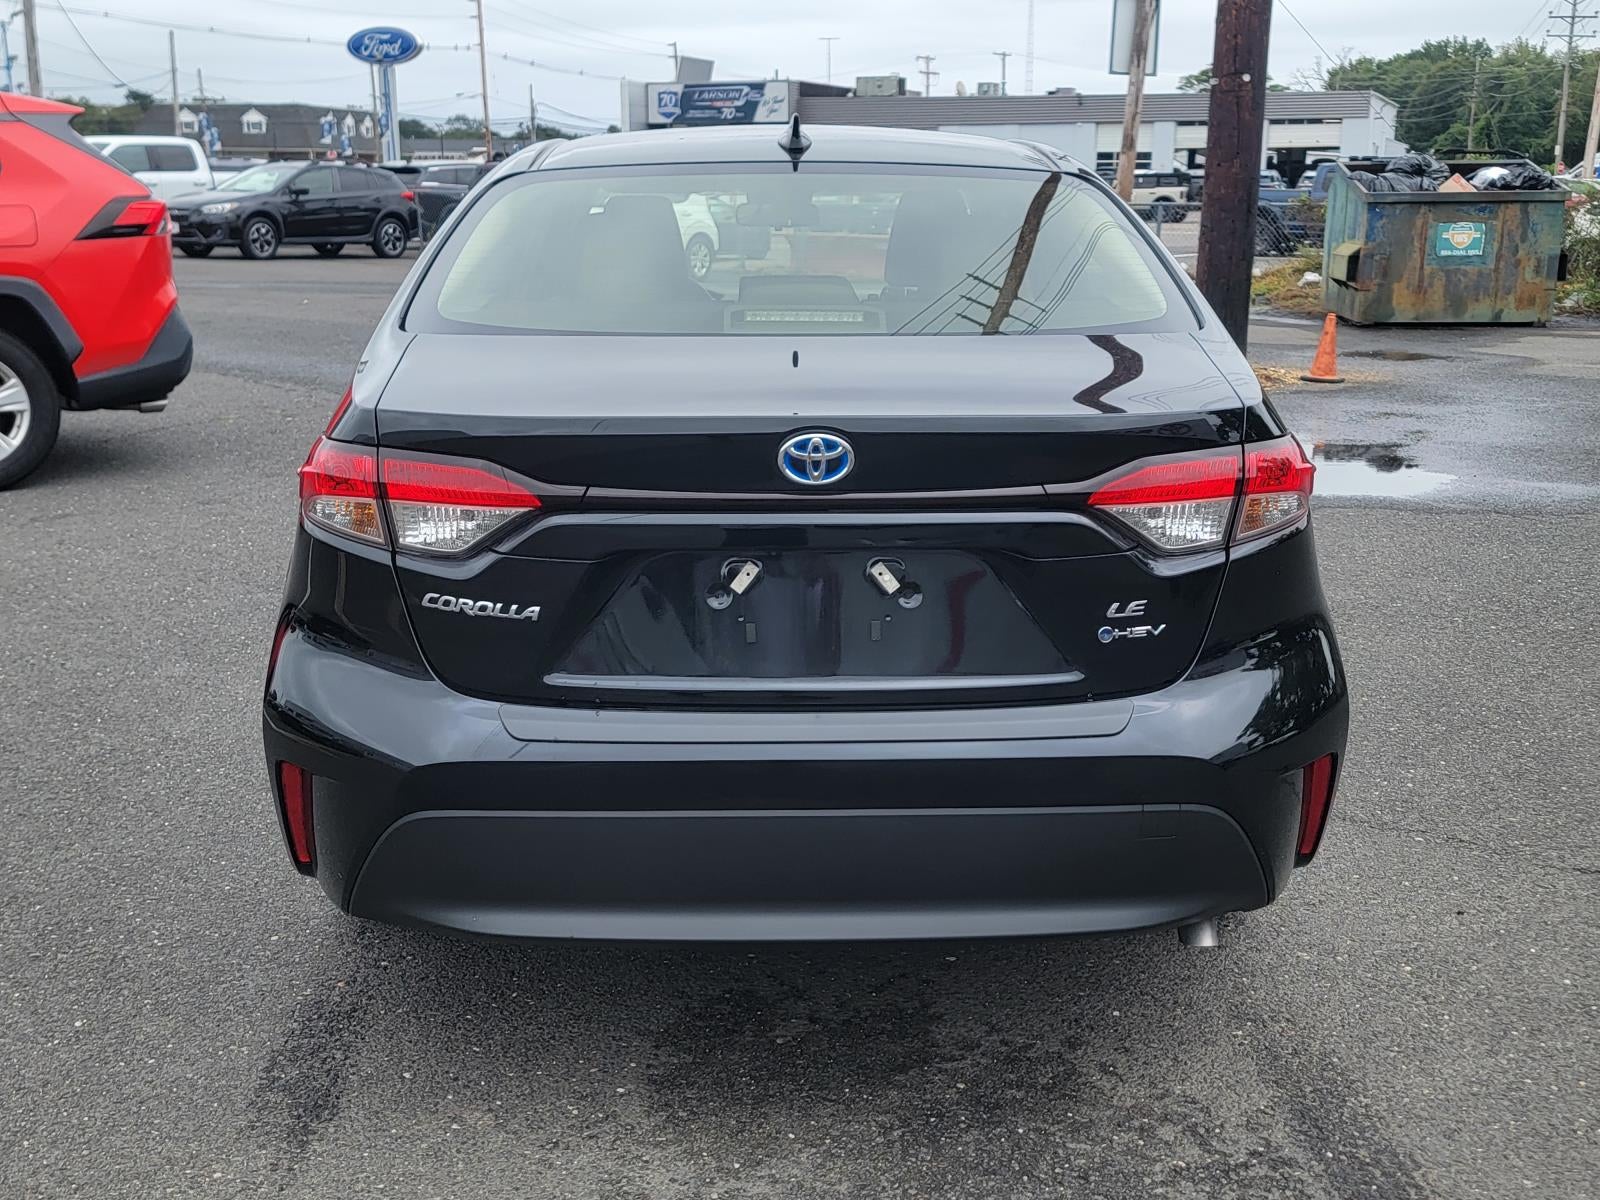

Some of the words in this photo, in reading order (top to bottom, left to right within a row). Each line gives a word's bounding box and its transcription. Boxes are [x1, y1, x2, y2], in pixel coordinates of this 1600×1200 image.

[362, 33, 402, 56] Ford
[659, 93, 676, 107] 70
[694, 90, 741, 100] LARSON
[720, 108, 736, 120] 70
[421, 592, 541, 622] COROLLA
[1106, 599, 1148, 618] LE
